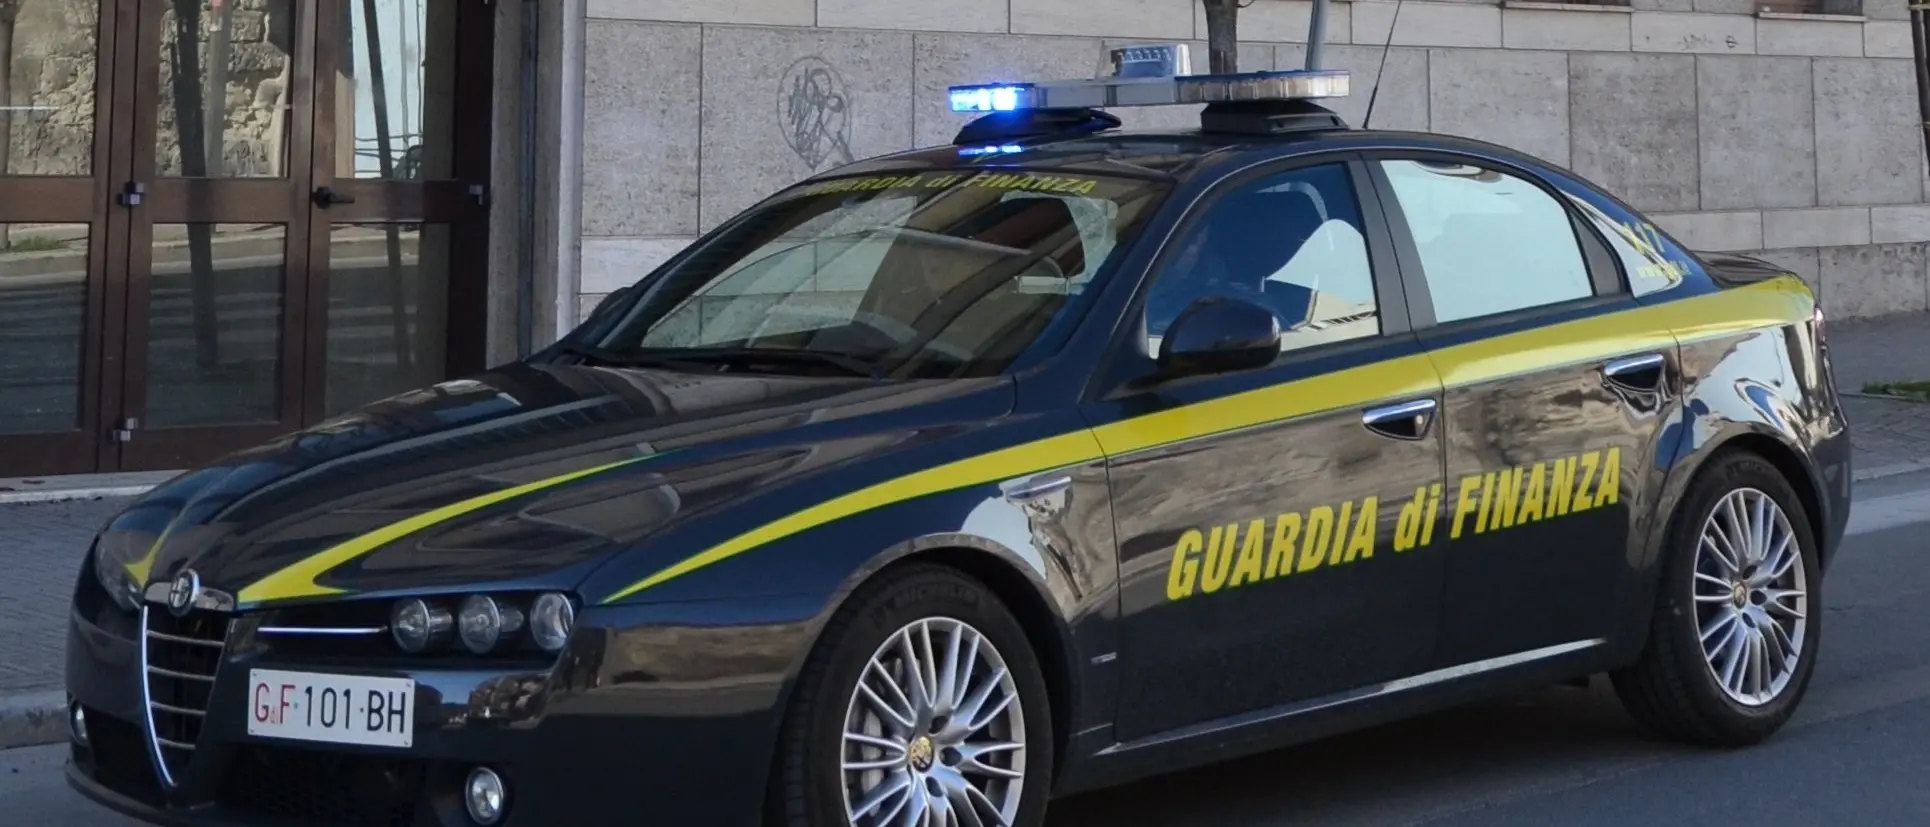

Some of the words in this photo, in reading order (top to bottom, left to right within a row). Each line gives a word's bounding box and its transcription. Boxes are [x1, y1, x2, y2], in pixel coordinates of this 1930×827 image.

[926, 173, 957, 188] di
[963, 171, 1097, 193] FINANZA
[1166, 495, 1378, 600] GUARDIA
[1393, 483, 1441, 552] di
[1450, 446, 1621, 539] FINANZA
[304, 686, 351, 729] 101
